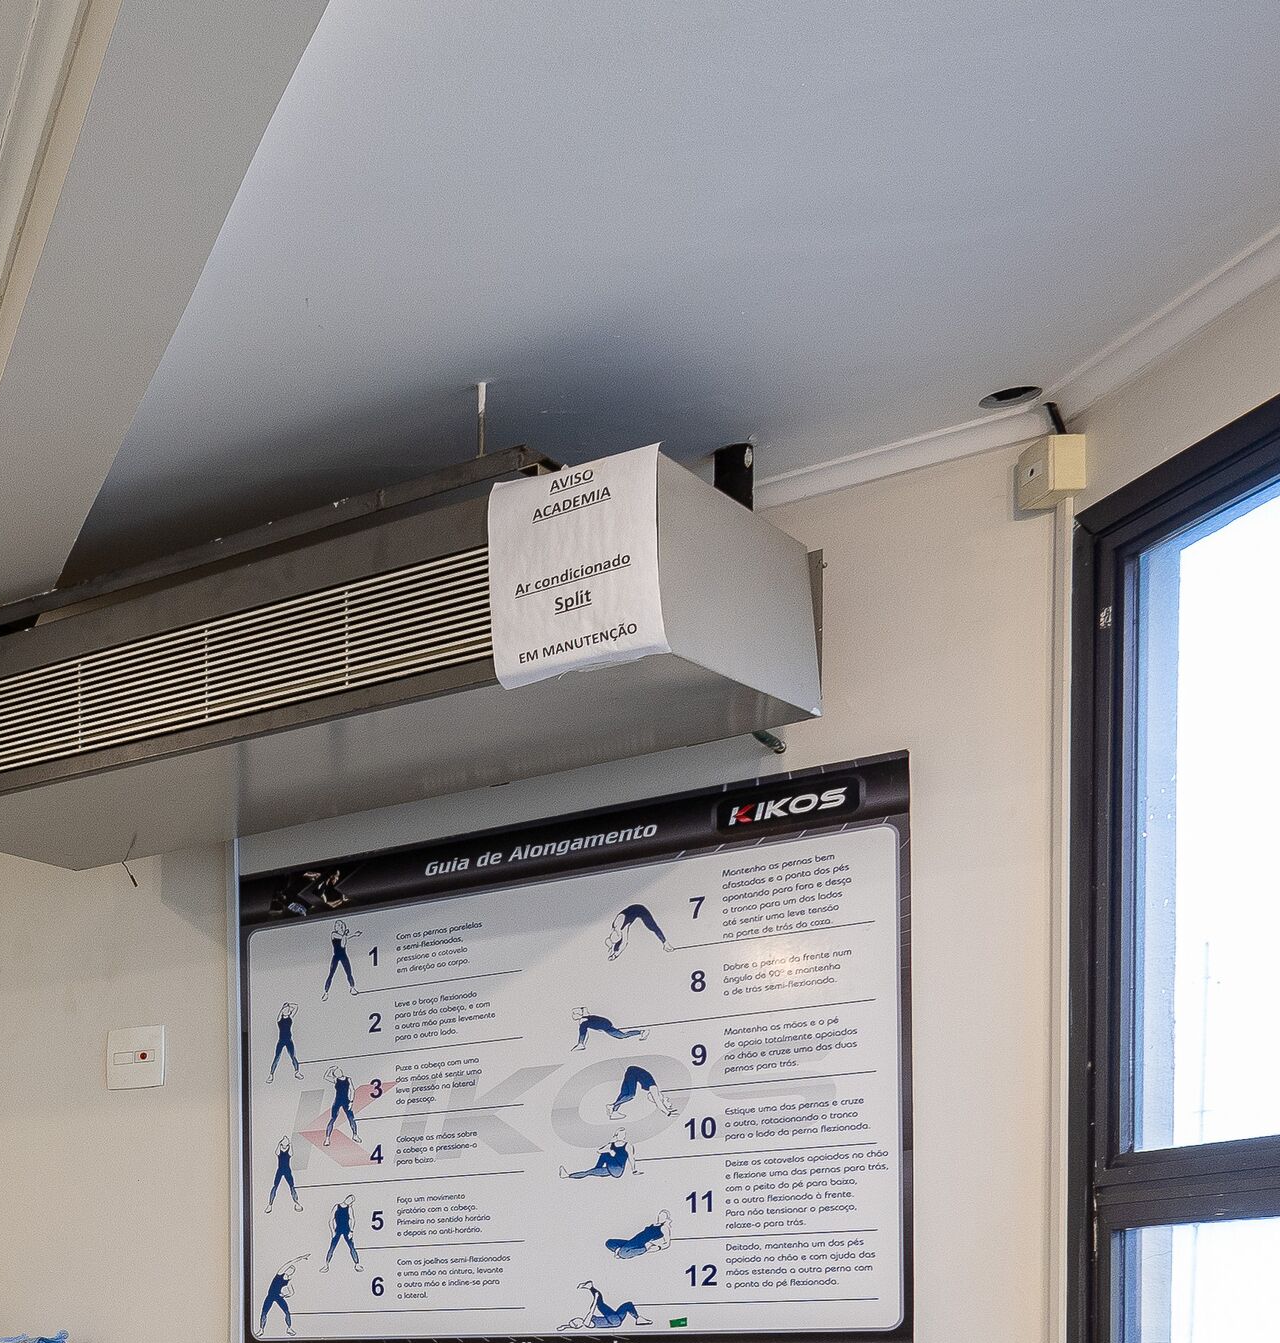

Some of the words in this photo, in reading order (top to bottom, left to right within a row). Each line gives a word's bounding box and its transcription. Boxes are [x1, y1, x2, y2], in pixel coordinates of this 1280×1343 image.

[550, 469, 594, 494] AVISO
[532, 486, 611, 522] ACADEMIA
[515, 582, 531, 597] Ar
[535, 553, 632, 591] condicionado
[554, 589, 592, 612] Split
[519, 649, 539, 664] EM
[542, 622, 638, 657] MANUTENÇÃO
[728, 787, 848, 826] KIKOS
[425, 856, 469, 877] Guia
[477, 851, 502, 867] de
[508, 822, 658, 862] Alongamento
[722, 865, 767, 877] Mantenha
[782, 858, 813, 870] pernas
[722, 878, 766, 889] afastadas
[785, 871, 812, 882] ponta
[833, 864, 849, 874] pés
[723, 889, 770, 903] apontando
[772, 886, 794, 896] para
[825, 878, 852, 886] desça
[689, 896, 706, 920] 7
[731, 904, 758, 913] tronco
[760, 901, 781, 911] para
[799, 895, 816, 903] dos
[818, 891, 843, 900] lados
[723, 918, 737, 927] até
[740, 915, 764, 924] sentir
[809, 904, 840, 914] tensão
[736, 929, 760, 940] parte
[776, 923, 793, 931] trás
[796, 921, 808, 929] da
[368, 946, 378, 966] 1
[690, 970, 706, 993] 8
[368, 1012, 382, 1033] 2
[724, 1025, 768, 1035] Mantenha
[784, 1021, 808, 1029] mãos
[827, 1016, 839, 1026] pé
[738, 1039, 763, 1048] apoio
[765, 1034, 813, 1044] totalmente
[815, 1028, 858, 1040] apoiados
[691, 1044, 707, 1066] 9
[737, 1051, 759, 1059] chão
[816, 1043, 833, 1051] das
[725, 1065, 754, 1074] pernas
[757, 1063, 777, 1071] para
[780, 1059, 798, 1067] trás.
[370, 1078, 382, 1098] 3
[799, 1101, 830, 1110] pernas
[684, 1116, 716, 1140] 10
[761, 1114, 819, 1124] rotacionando
[725, 1133, 746, 1142] para
[778, 1128, 790, 1136] da
[792, 1128, 819, 1136] perna
[821, 1123, 871, 1132] flexionada.
[370, 1144, 384, 1164] 4
[686, 1190, 713, 1214] 11
[371, 1210, 384, 1230] 5
[726, 1243, 762, 1251] Deitado,
[765, 1241, 810, 1249] mantenha
[828, 1239, 845, 1247] dos
[847, 1238, 864, 1247] pés
[726, 1255, 762, 1265] apoiado
[830, 1252, 856, 1261] ajuda
[685, 1264, 718, 1287] 12
[752, 1267, 788, 1275] estenda
[825, 1266, 852, 1274] perna
[372, 1276, 384, 1296] 6
[734, 1281, 760, 1289] ponta
[776, 1279, 788, 1288] pé
[790, 1278, 839, 1286] flexionada.
